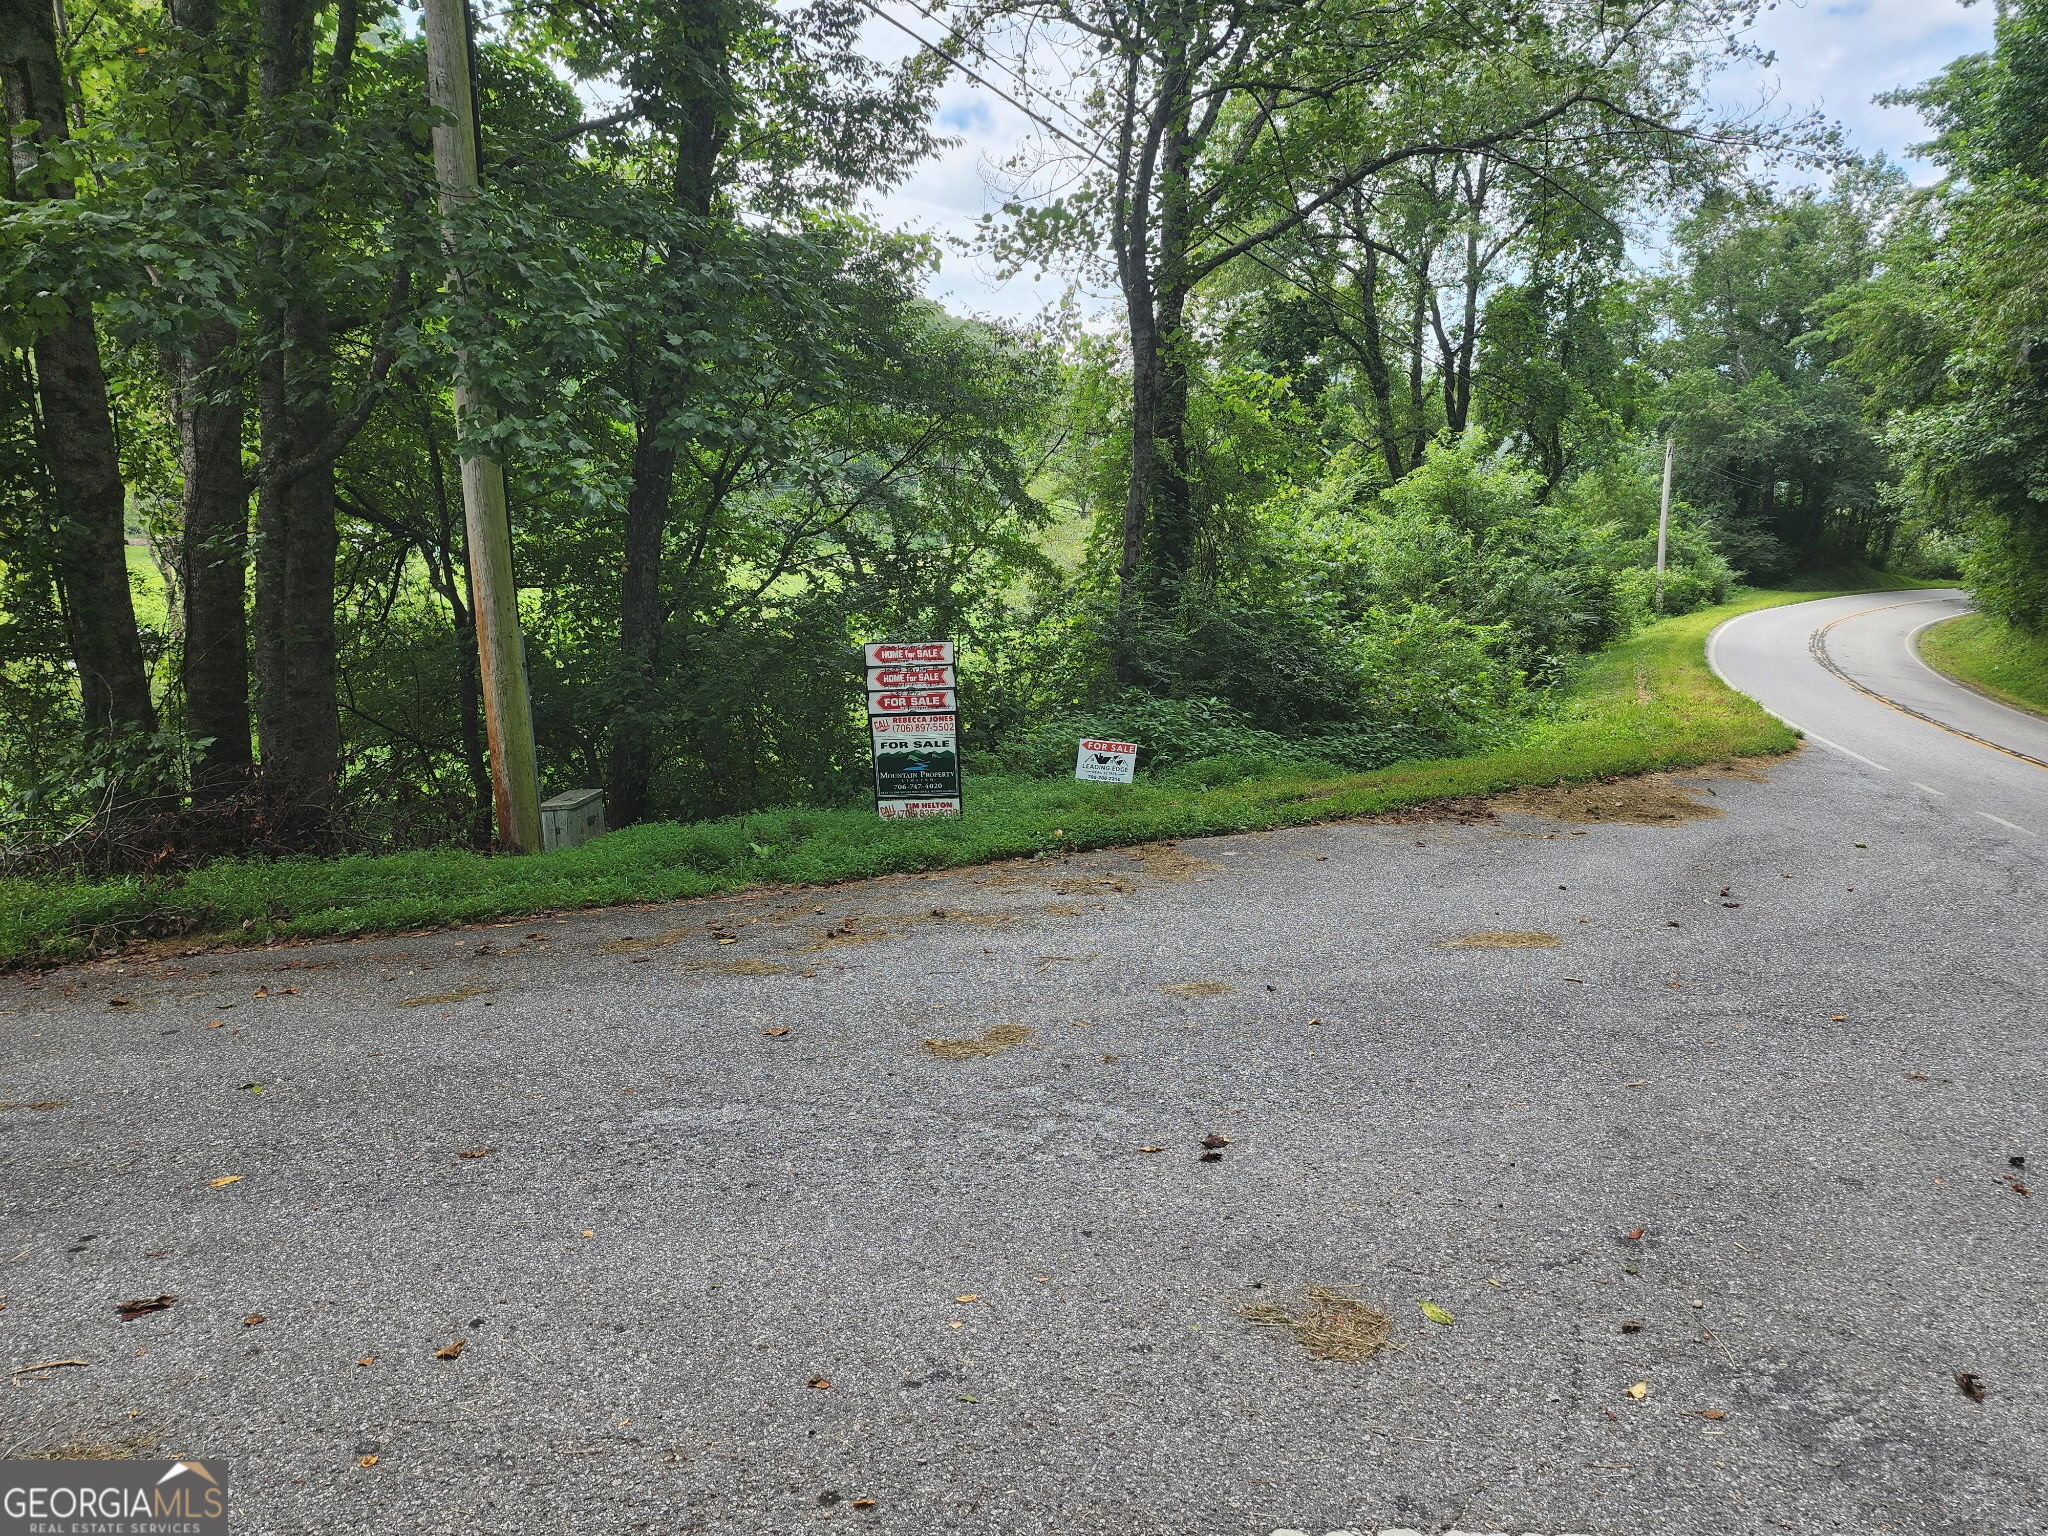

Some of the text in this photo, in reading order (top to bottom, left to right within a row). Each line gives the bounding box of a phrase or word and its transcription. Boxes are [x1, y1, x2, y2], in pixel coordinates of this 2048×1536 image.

[881, 649, 938, 659] HOME for SALE
[883, 672, 940, 683] HOME for SALE
[884, 696, 940, 707] FOR SALE
[873, 719, 890, 730] CALL
[892, 715, 954, 724] REBECCA JONES
[892, 722, 955, 733] (706) 897-5502
[880, 740, 950, 750] FOR SALE
[1087, 742, 1135, 753] FOR SALE
[920, 770, 955, 778] PROPERTY
[893, 782, 943, 790] 706-747-4020
[879, 803, 896, 815] CALL
[921, 801, 953, 809] HELTON
